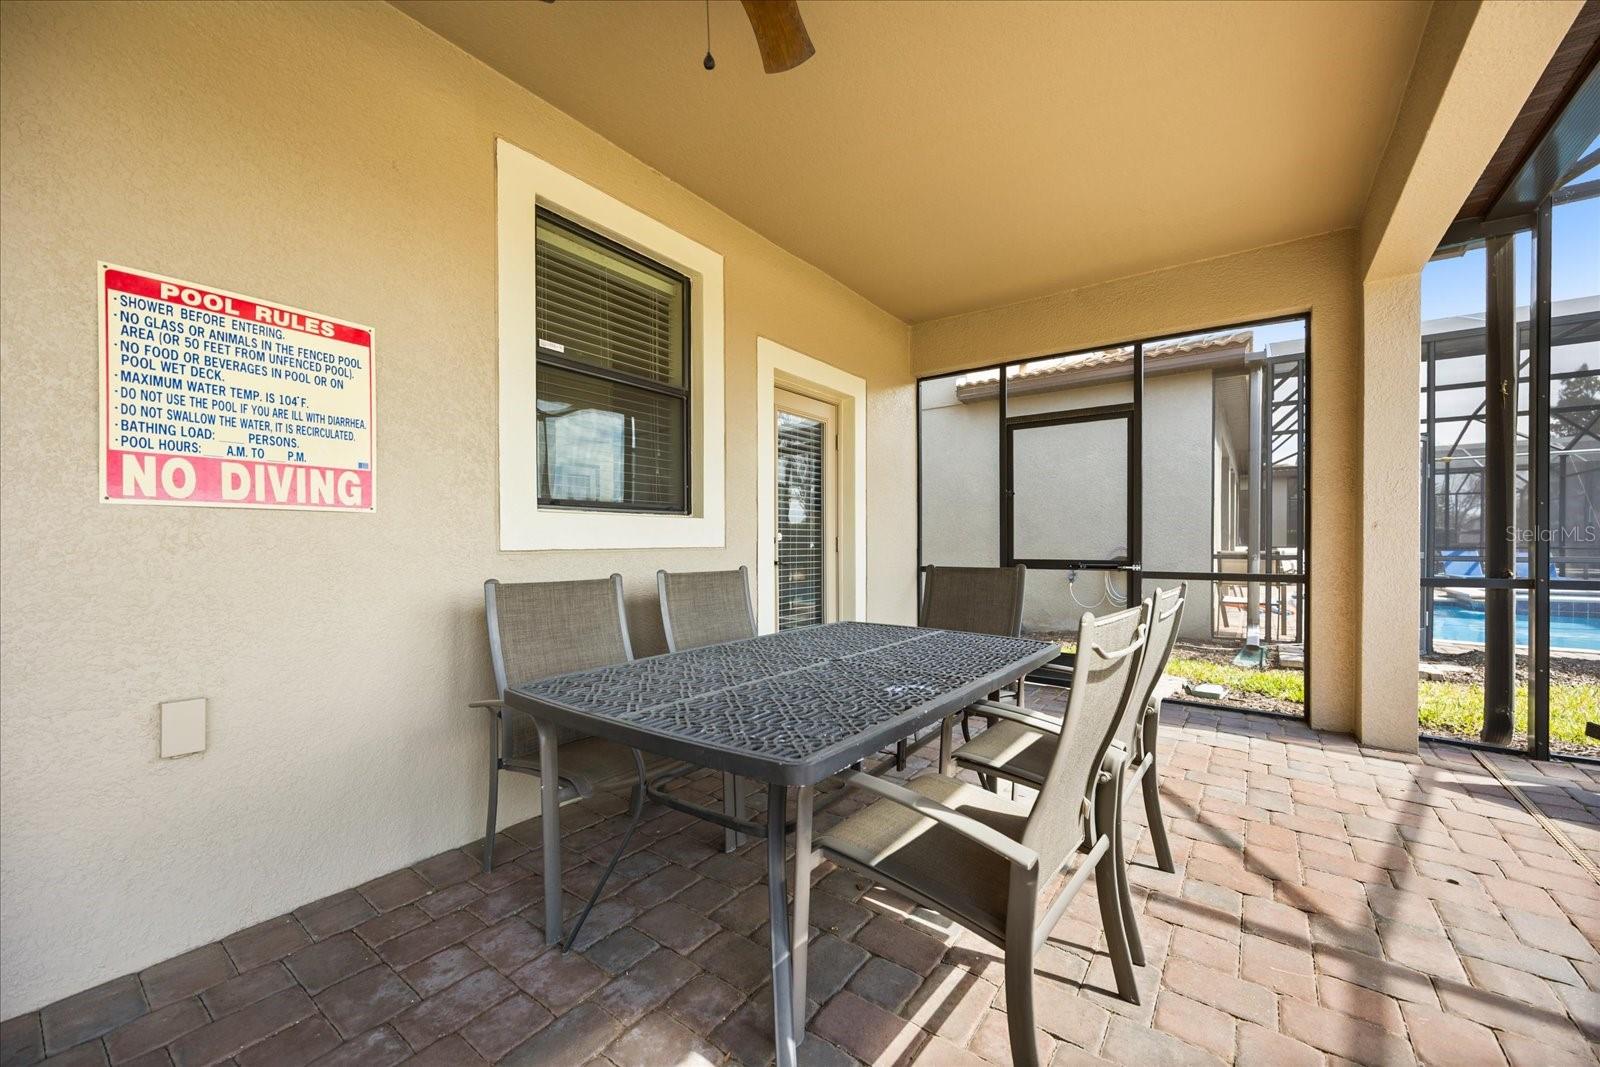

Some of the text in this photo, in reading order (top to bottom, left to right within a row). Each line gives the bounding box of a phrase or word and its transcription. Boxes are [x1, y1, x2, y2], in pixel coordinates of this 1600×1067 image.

[120, 295, 285, 340] SHOWER BEFORE ENTERING.
[160, 283, 335, 337] POOL RULES
[120, 310, 362, 369] NO GLASS OR ANIMALS IN THE FENCED POOL
[121, 325, 354, 380] AREA (OR 50 FEET FROM UNFENCED POOL).
[120, 340, 344, 390] NO FOOD OR BEVERAGES IN POOL OR ON
[121, 354, 225, 382] POOL WET DECK.
[121, 370, 183, 390] MAXIMUM
[186, 380, 226, 396] WATER
[230, 387, 262, 402] TEMP.
[266, 392, 275, 404] IS
[121, 386, 136, 400] DO
[140, 389, 163, 403] NOT
[166, 393, 186, 406] USE
[189, 396, 208, 409] THE
[212, 399, 237, 413] POOL
[240, 403, 248, 414] IF
[251, 404, 270, 417] YOU
[272, 408, 289, 419] ARE
[291, 410, 303, 422] ILL
[305, 412, 325, 425] WITH
[121, 403, 355, 442] DO NOT SWALLOW THE WATER, IT IS RECIRCULATED.
[121, 419, 300, 448] BATHING LOAD: PERSONS.
[121, 435, 307, 462] POOL HOURS: A.M. TO P.M.
[122, 453, 362, 506] NO DIVING
